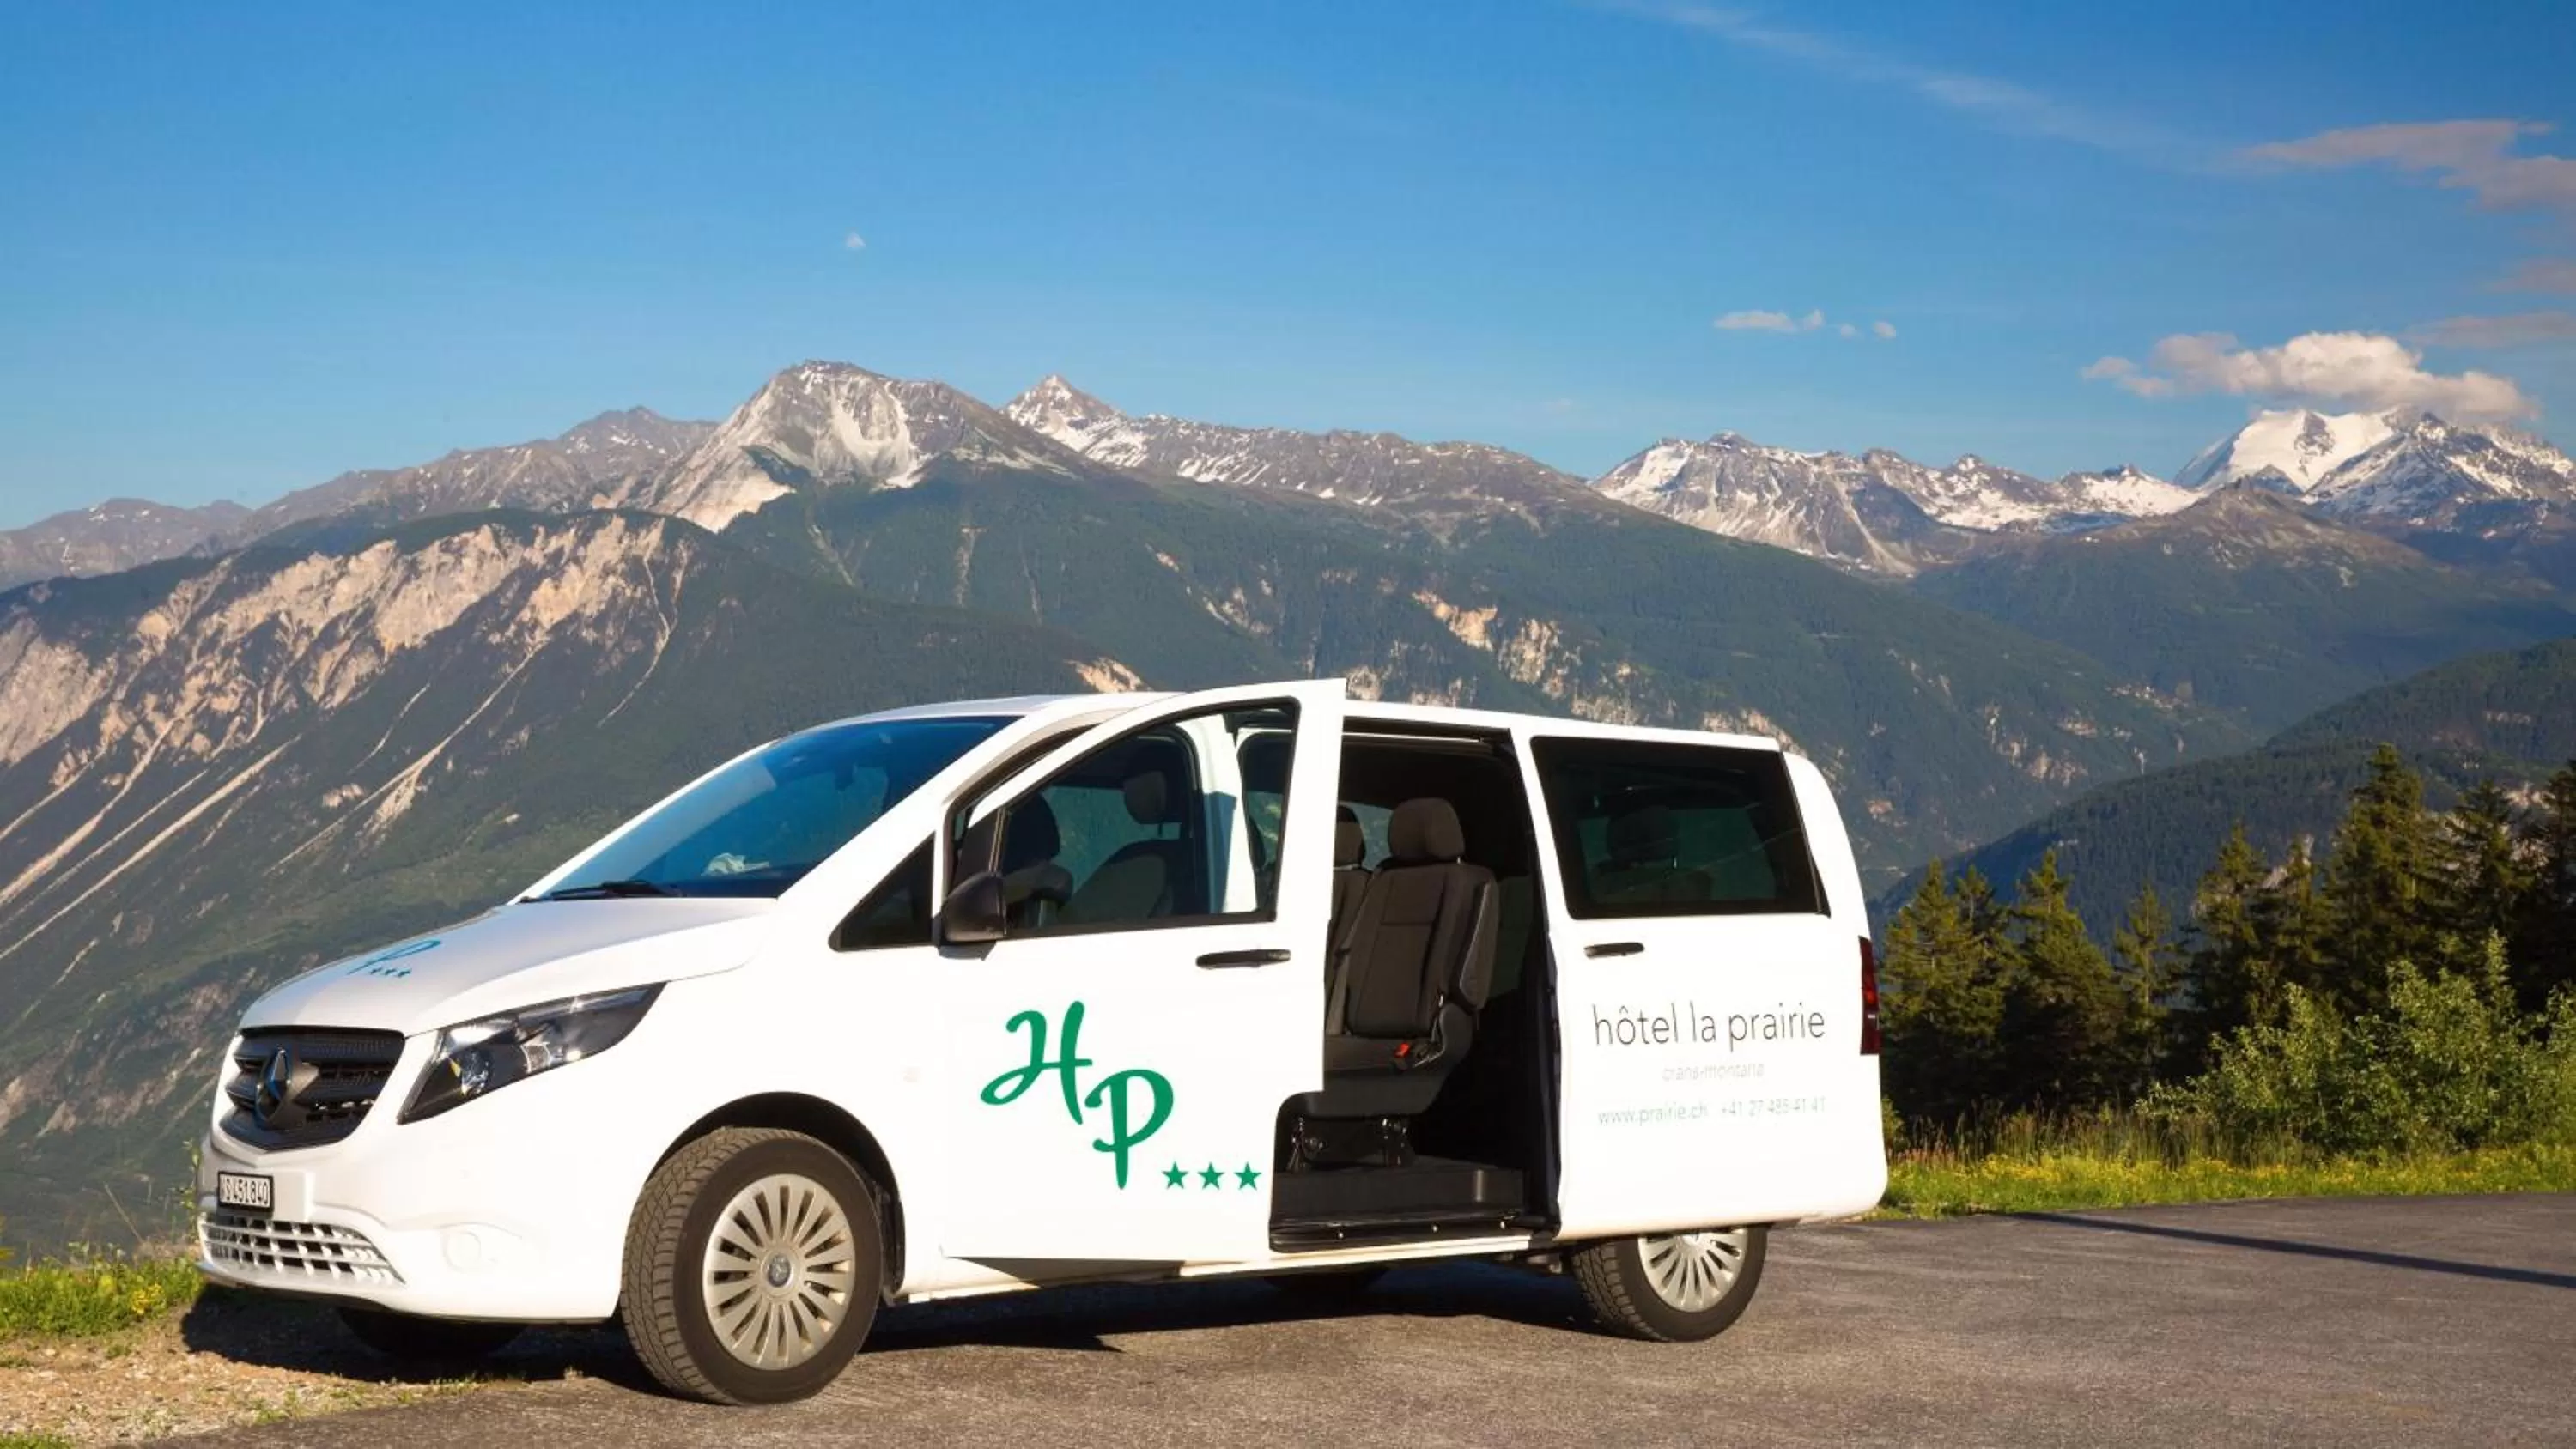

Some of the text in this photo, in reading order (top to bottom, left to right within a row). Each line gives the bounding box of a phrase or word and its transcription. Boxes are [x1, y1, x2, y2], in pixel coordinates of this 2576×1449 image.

[1593, 1000, 1826, 1053] hôtel la prairie
[1597, 1101, 1709, 1127] www.prairie.ch
